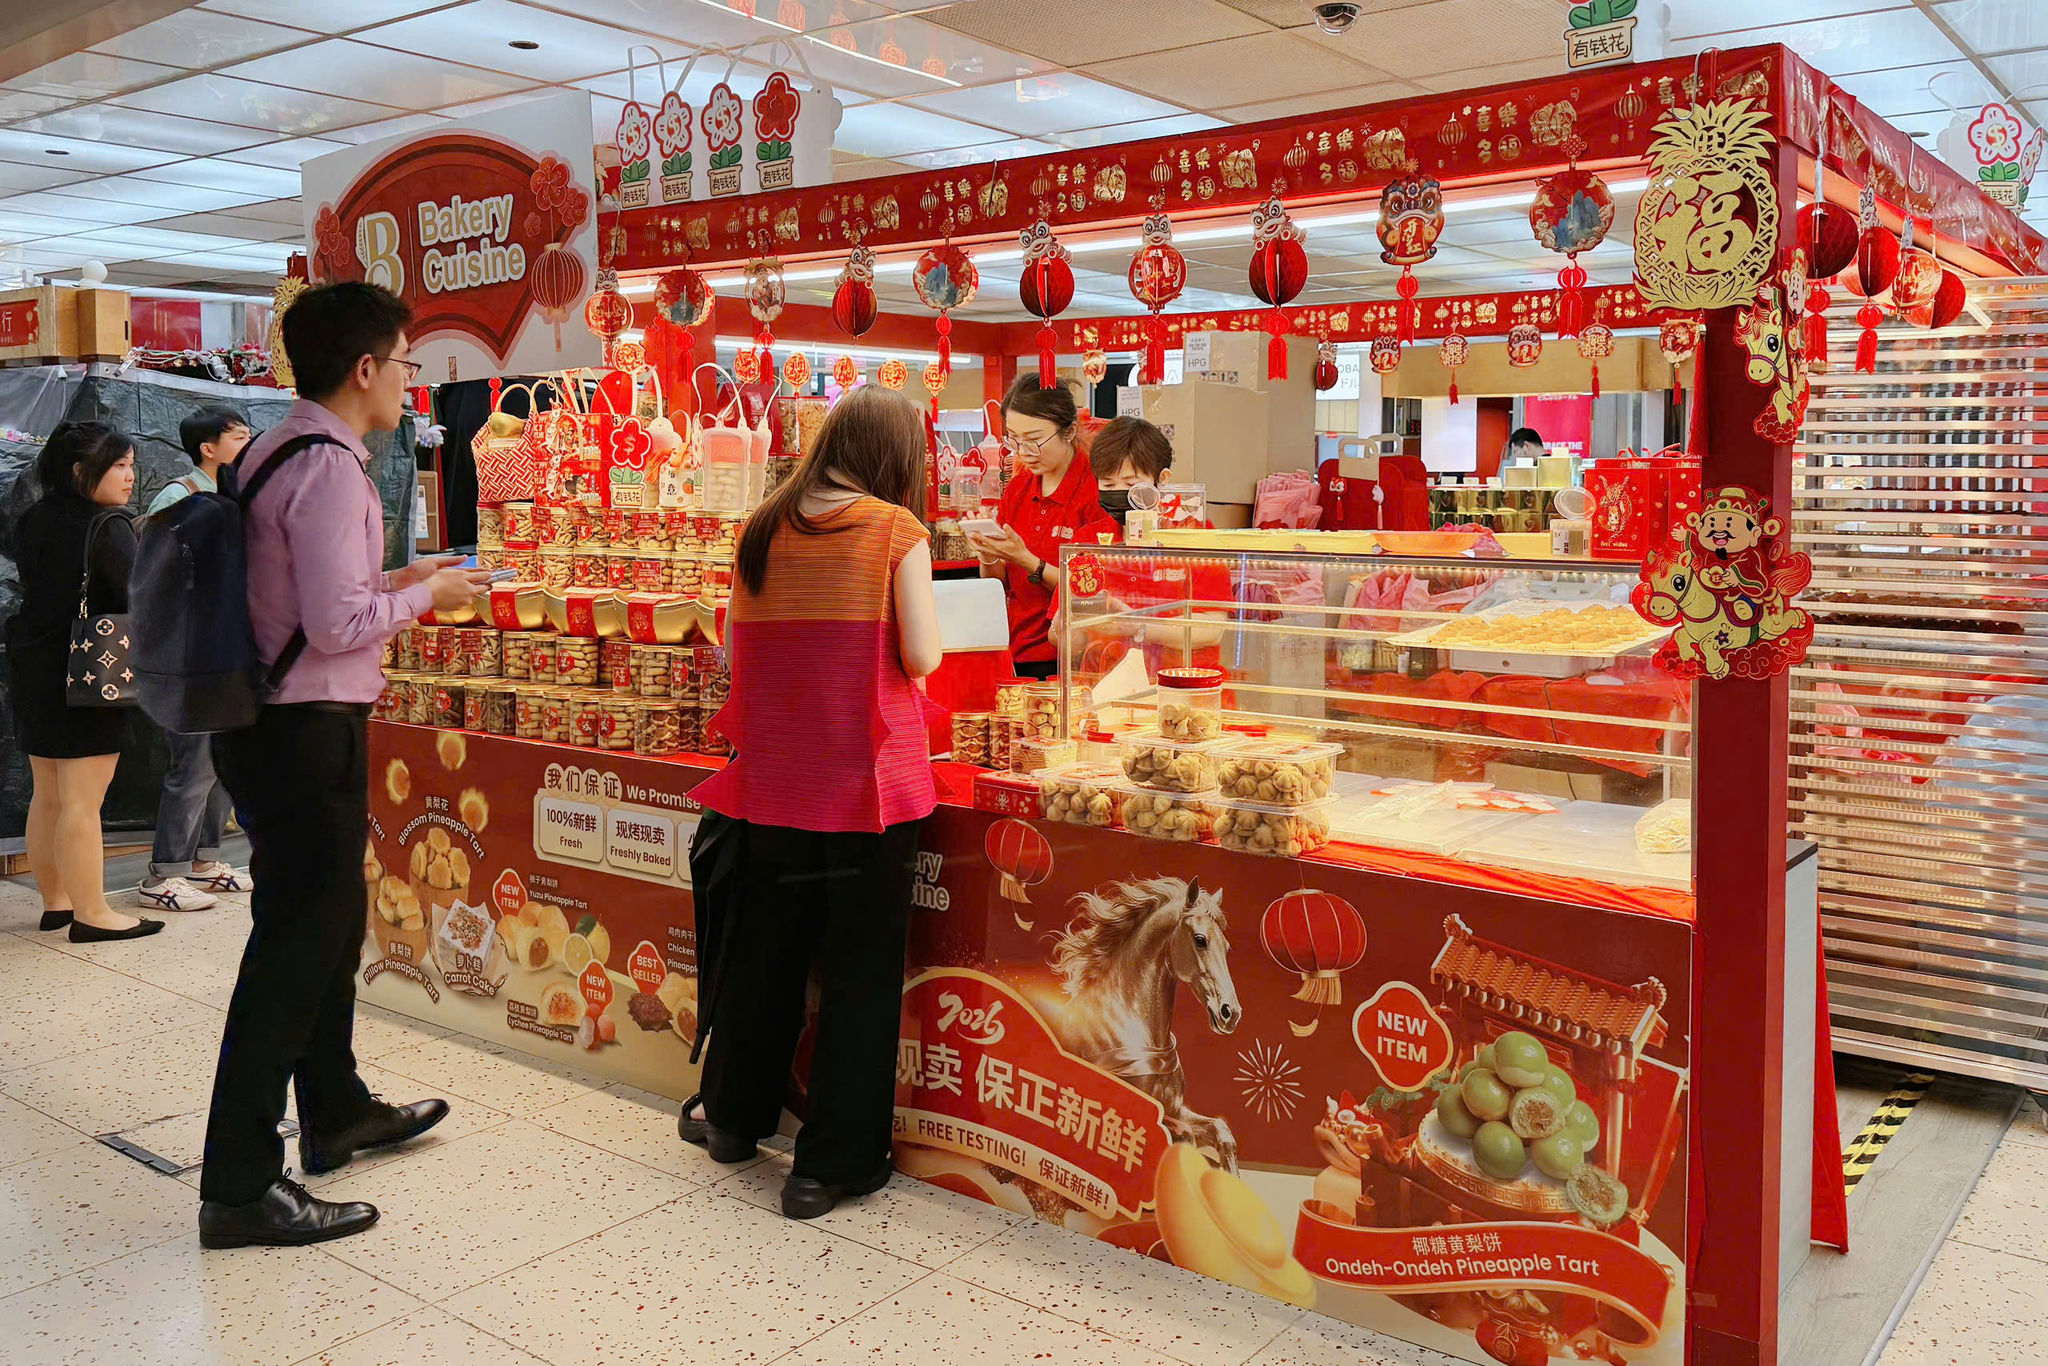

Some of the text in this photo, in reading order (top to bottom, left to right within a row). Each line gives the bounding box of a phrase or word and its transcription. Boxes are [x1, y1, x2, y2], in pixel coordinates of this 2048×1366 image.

[1573, 34, 1629, 60] 有钱花
[712, 176, 738, 190] 有钱花
[762, 169, 790, 183] 有钱花
[622, 190, 648, 203] 有钱花
[664, 184, 688, 197] 有钱花
[419, 195, 513, 246] Bakery
[1653, 170, 1754, 275] 福
[423, 238, 526, 294] Cuisine
[1188, 358, 1207, 367] HPG
[1121, 407, 1141, 417] HPG
[547, 768, 619, 799] 我们保证
[425, 796, 449, 811] 黄梨花
[627, 784, 700, 810] We Promise
[371, 816, 386, 841] Tart
[546, 808, 597, 833] 100%新鲜
[398, 812, 485, 860] Blossom Pineapple Tart
[559, 836, 583, 849] Fresh
[616, 820, 665, 846] 现烤现卖
[610, 845, 671, 866] Freshly Baked
[501, 883, 520, 896] NEW
[529, 890, 588, 910] Yuzu Pineapple Tart
[501, 897, 520, 909] ITEM
[668, 926, 697, 941] 鸡肉肉干
[667, 942, 695, 956] Chicken
[637, 955, 658, 969] BEST
[364, 959, 439, 1002] Pillow Pineapple Tart
[445, 973, 495, 995] Carrot Cake
[586, 974, 606, 988] NEW
[633, 968, 661, 985] SELLER
[587, 988, 606, 1002] ITEM
[938, 990, 1006, 1045] 2026
[1377, 1009, 1428, 1037] NEW
[508, 1016, 573, 1043] Lychee Pineapple Tart
[1377, 1036, 1428, 1065] ITEM
[918, 1119, 954, 1142] FREE
[956, 1128, 1026, 1167] TESTING!
[1412, 1232, 1502, 1256] 椰糖黄梨饼
[1325, 1253, 1600, 1277] Ondeh-Ondeh Pineapple Tart
